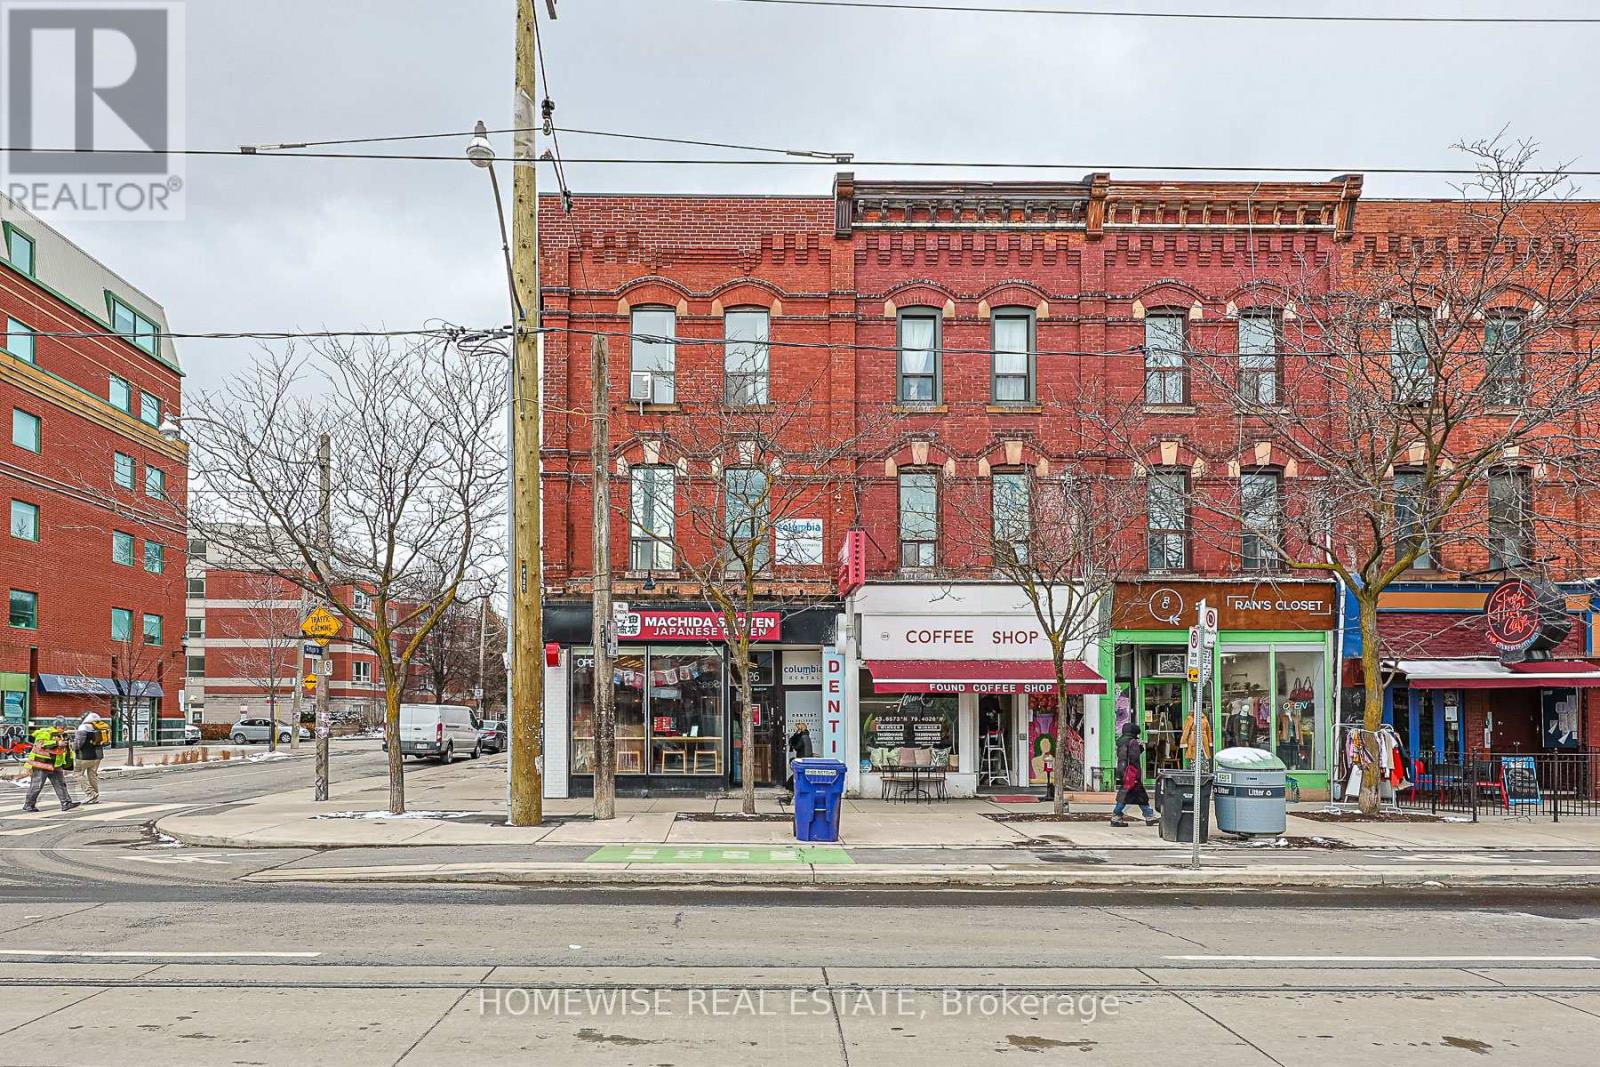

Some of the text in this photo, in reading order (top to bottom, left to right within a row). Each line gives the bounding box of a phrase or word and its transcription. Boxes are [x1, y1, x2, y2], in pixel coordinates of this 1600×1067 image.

[1235, 600, 1324, 611] RAN'S CLOSET
[645, 617, 714, 628] MACHIDA
[653, 628, 718, 636] JAPANESE
[906, 630, 975, 644] COFFEE
[992, 631, 1039, 645] SHOP
[930, 684, 1053, 693] FOUND COFFEE SHOP
[1248, 788, 1264, 796] Litter
